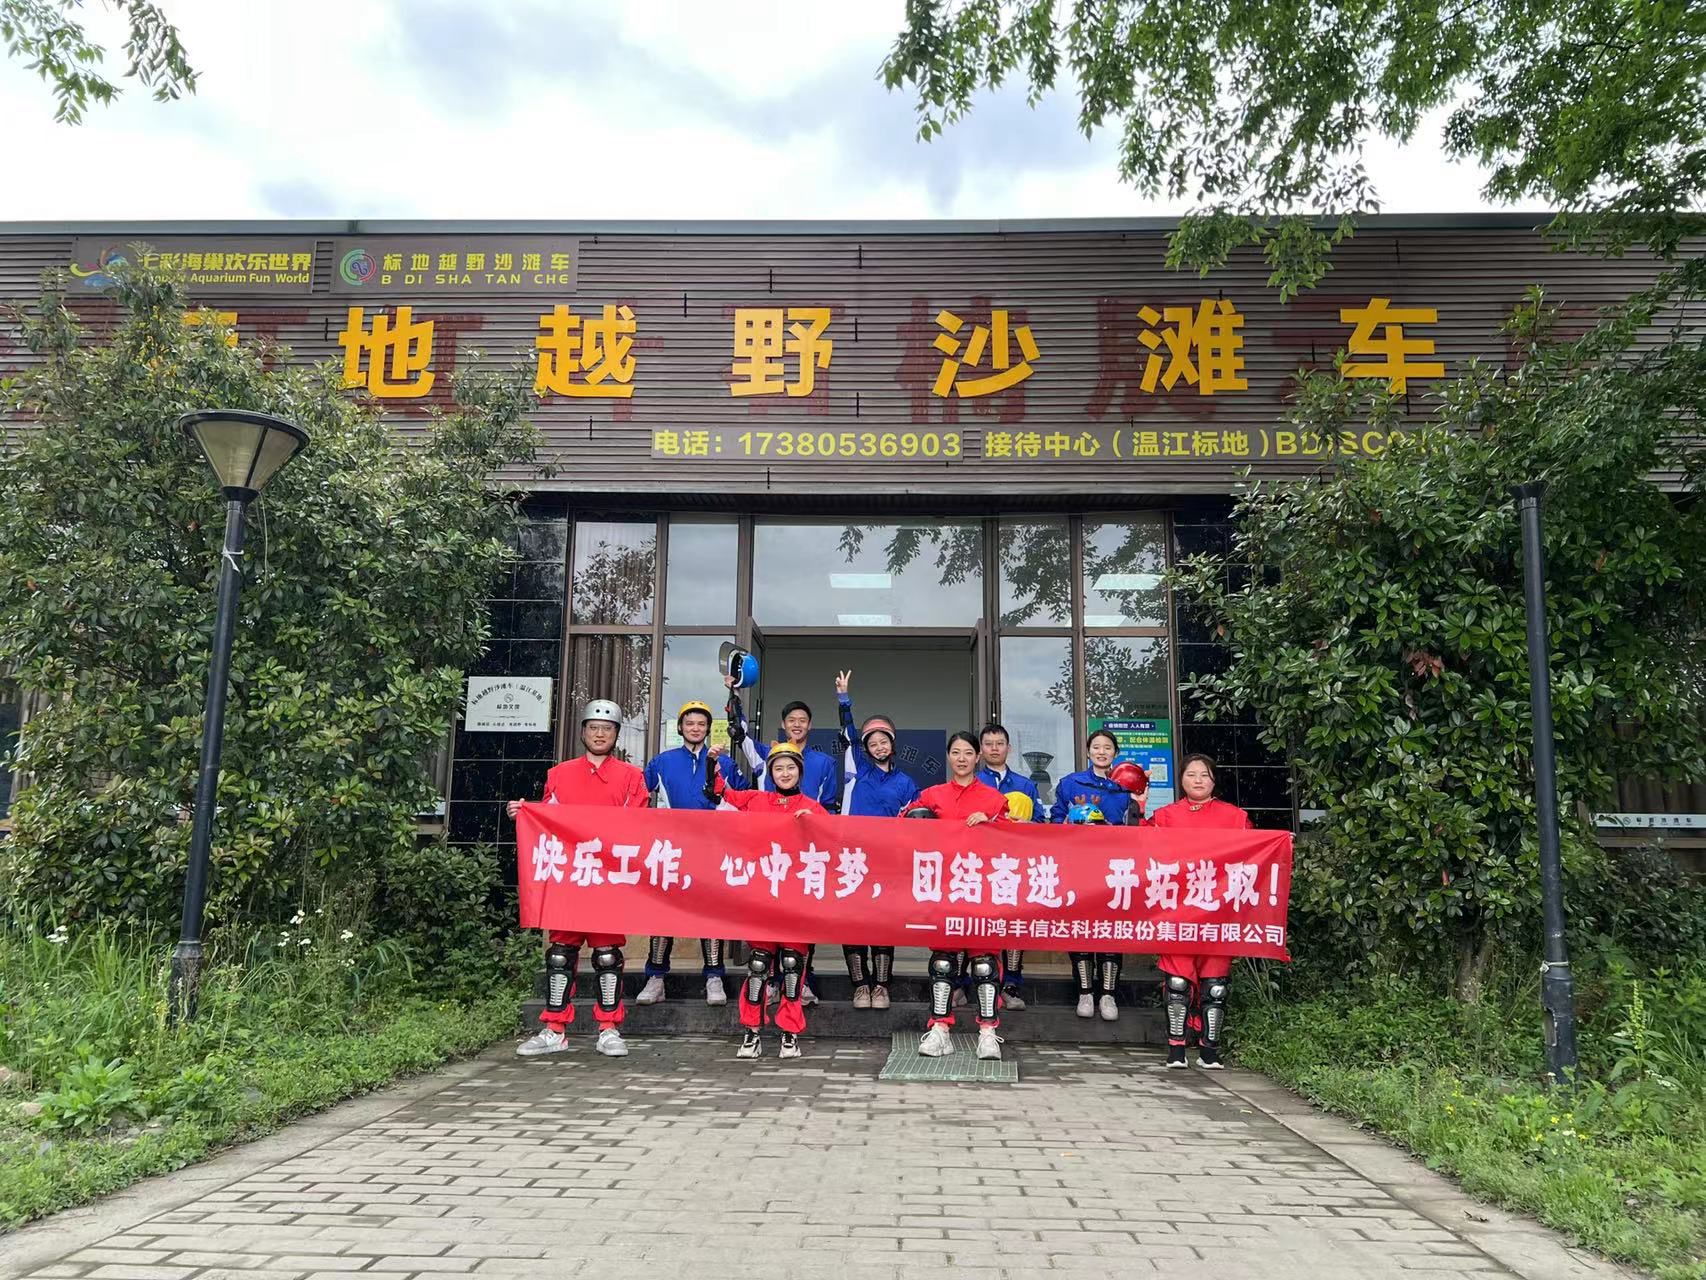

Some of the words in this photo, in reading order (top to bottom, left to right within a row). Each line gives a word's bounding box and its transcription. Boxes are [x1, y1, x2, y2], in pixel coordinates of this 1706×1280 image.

[382, 253, 569, 271] 标地越野沙滩车
[190, 272, 247, 284] Aquarium
[249, 273, 271, 283] Fun
[275, 272, 310, 284] World
[381, 274, 392, 284] B
[404, 274, 422, 285] DI
[435, 274, 472, 285] SHA
[484, 274, 521, 285] TAN
[534, 274, 569, 284] CHE
[150, 298, 1446, 400] 地越野沙滩车
